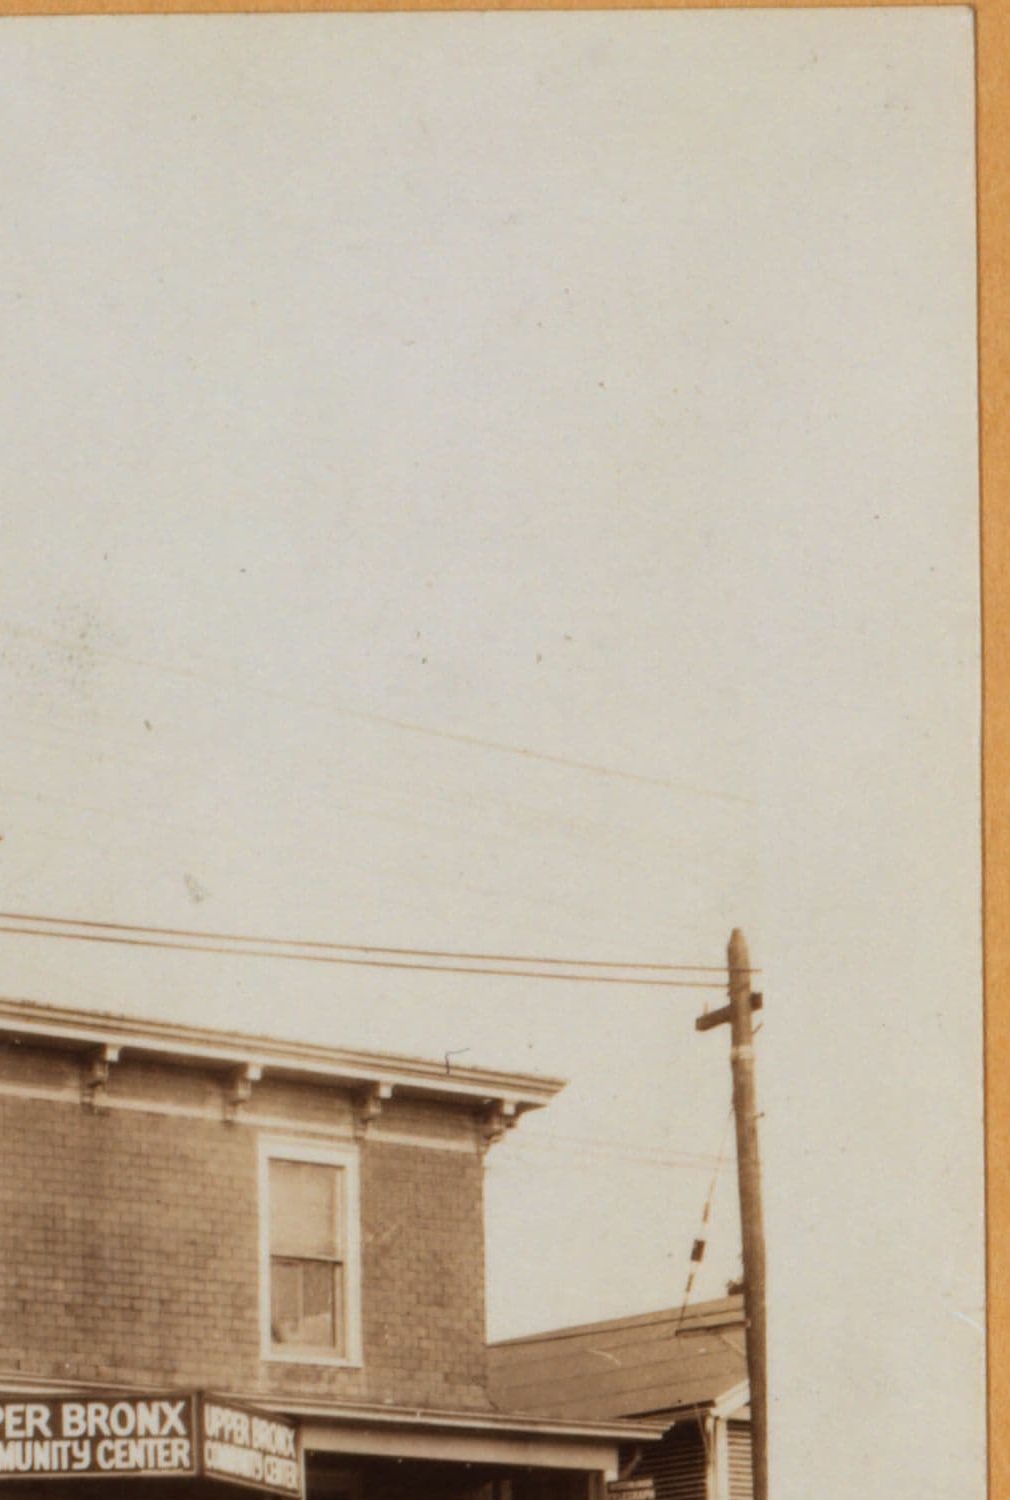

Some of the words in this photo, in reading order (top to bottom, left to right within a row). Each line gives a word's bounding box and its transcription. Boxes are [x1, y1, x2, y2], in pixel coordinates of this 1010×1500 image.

[61, 1400, 187, 1438] BRONX
[203, 1402, 250, 1447] UPPER
[252, 1415, 296, 1458] BRONX
[96, 1438, 190, 1470] CENTER
